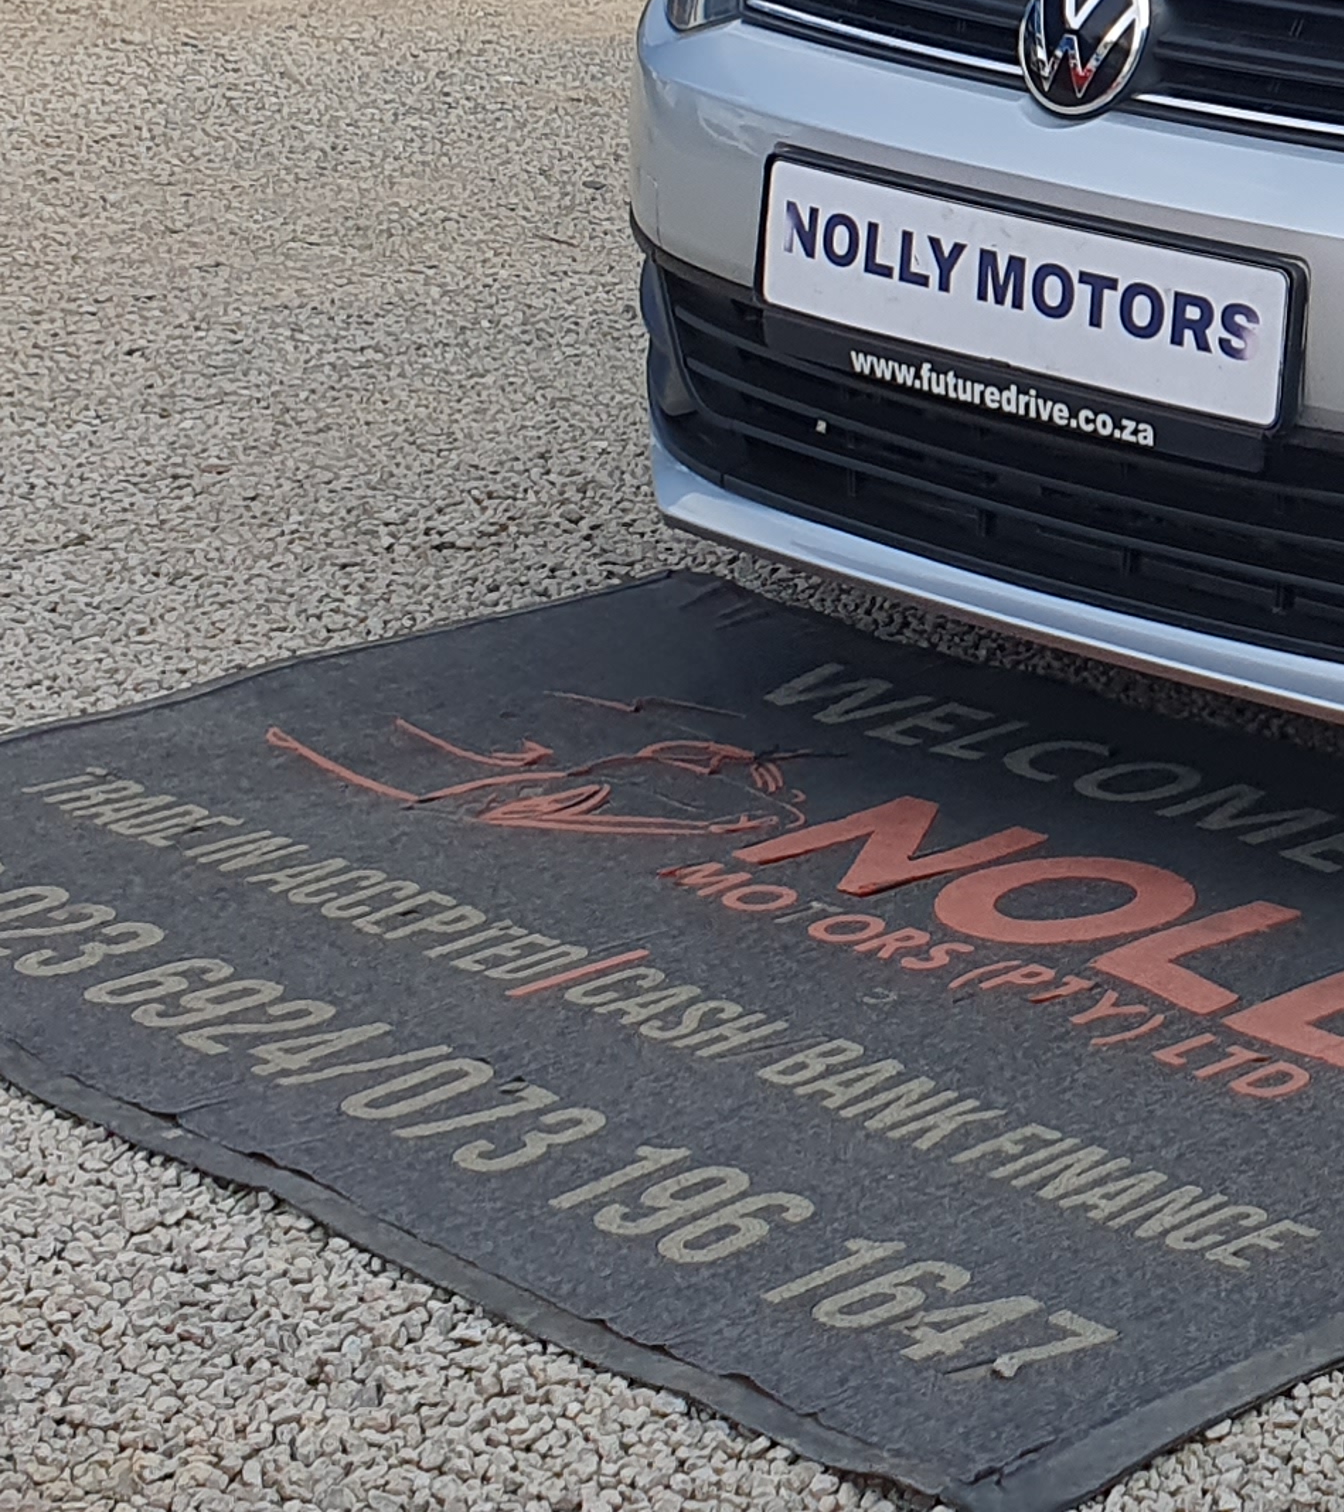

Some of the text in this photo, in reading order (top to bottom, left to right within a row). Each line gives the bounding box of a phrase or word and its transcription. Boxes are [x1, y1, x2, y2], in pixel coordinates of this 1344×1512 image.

[783, 199, 1261, 361] NOLLY MOTORS
[850, 349, 1155, 447] www.futuredrive.co.za
[21, 766, 245, 848] TRADE
[182, 829, 309, 873] IN
[948, 1122, 1322, 1269] FINANCE
[657, 861, 1311, 1099] MOTORS (PTY) LTD
[548, 1145, 816, 1264] 196
[760, 1237, 1119, 1379] 1647
